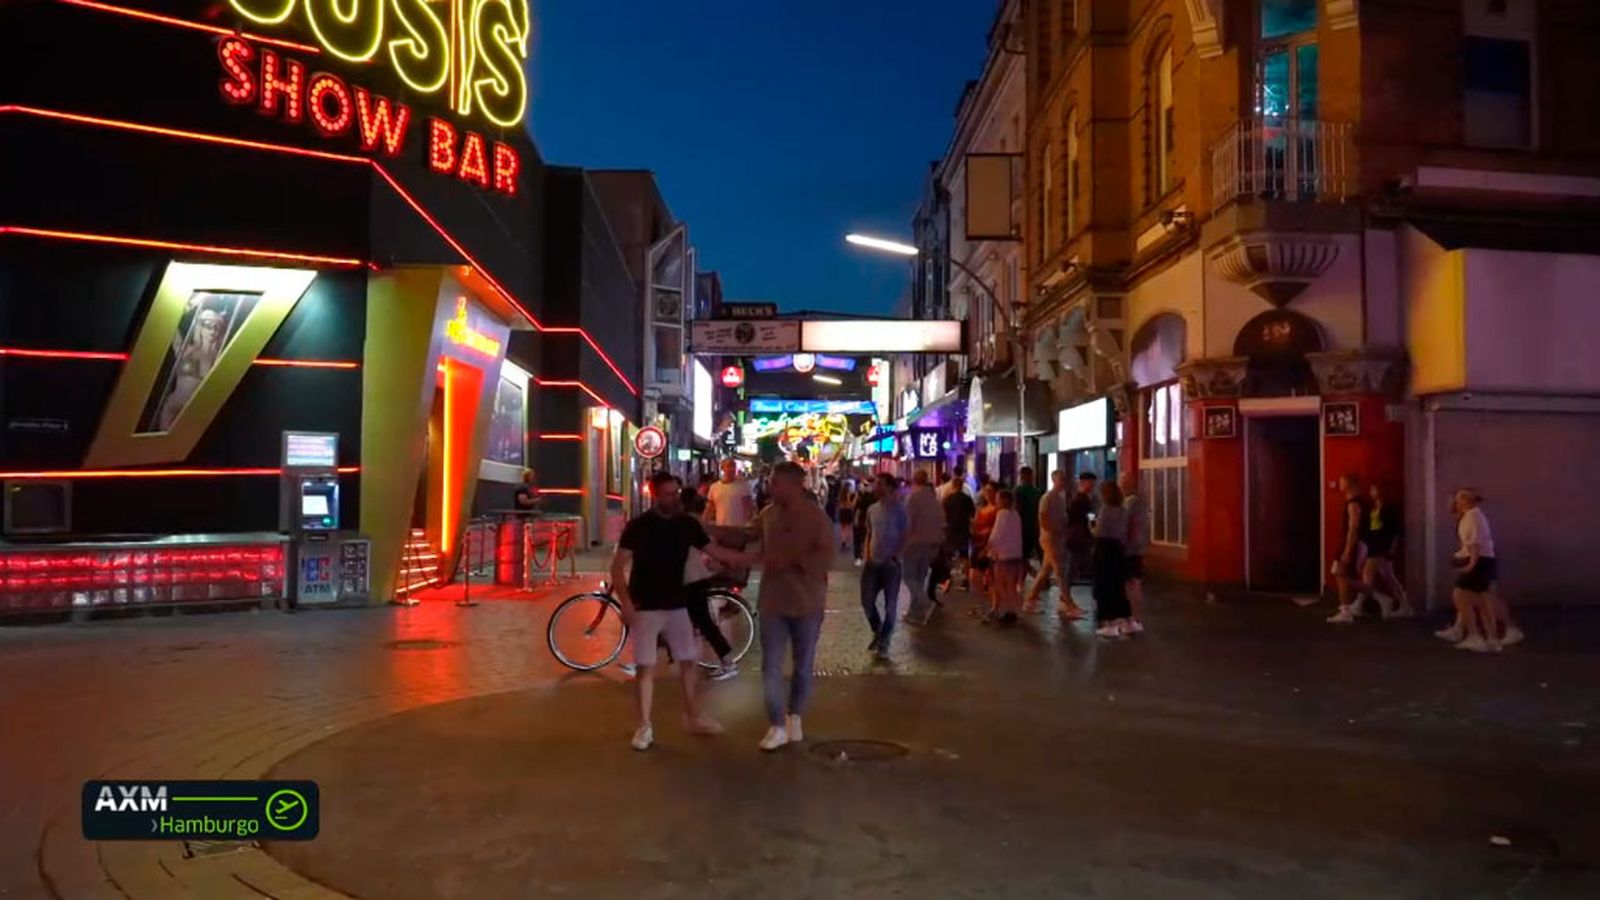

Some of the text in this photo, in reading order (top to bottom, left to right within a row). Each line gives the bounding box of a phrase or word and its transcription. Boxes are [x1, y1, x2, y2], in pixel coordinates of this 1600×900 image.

[217, 34, 521, 195] SHOW BAR
[304, 584, 331, 594] ATM
